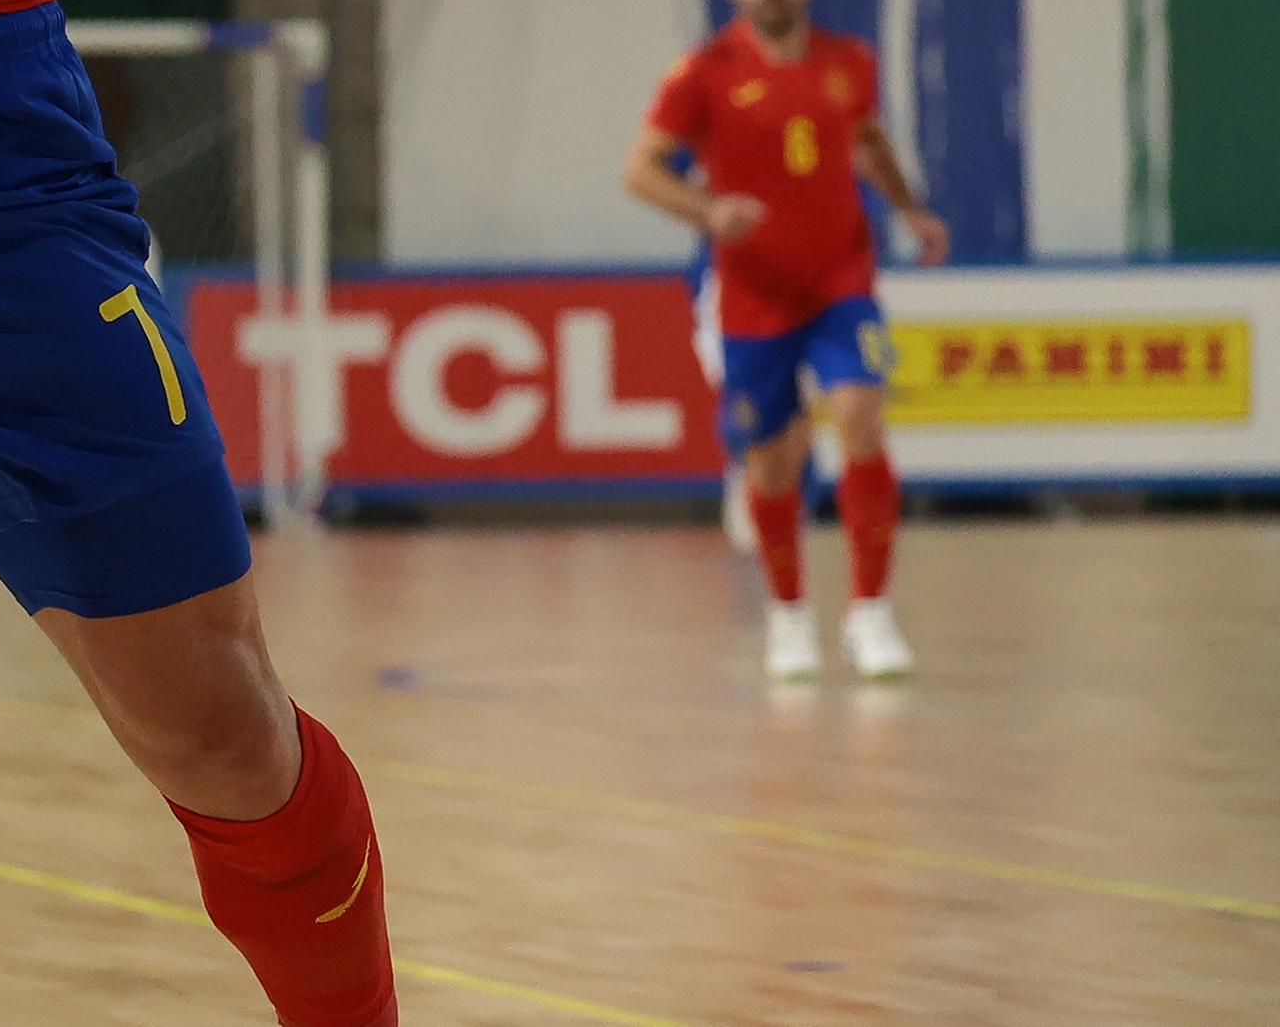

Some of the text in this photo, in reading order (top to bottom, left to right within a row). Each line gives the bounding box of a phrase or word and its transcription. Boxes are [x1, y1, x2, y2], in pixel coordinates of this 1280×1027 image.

[98, 283, 187, 425] 7
[238, 302, 686, 458] TCL
[939, 334, 1227, 384] PANINI
